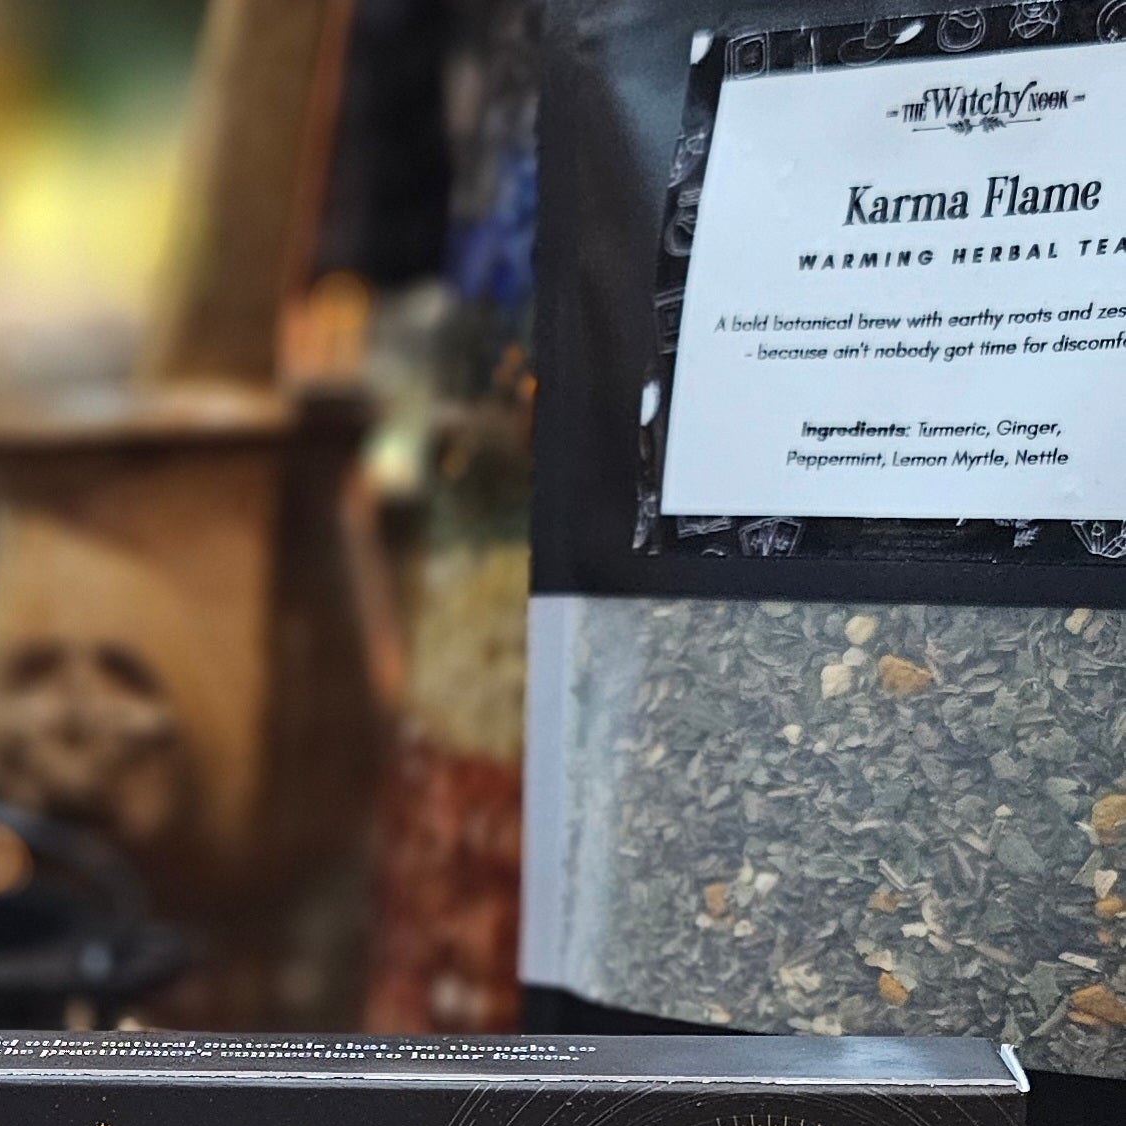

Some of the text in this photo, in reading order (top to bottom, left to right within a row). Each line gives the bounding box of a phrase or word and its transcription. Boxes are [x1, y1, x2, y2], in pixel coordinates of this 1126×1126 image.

[902, 80, 1069, 122] THE Witchy NOOK
[844, 174, 1102, 225] Karma Flame
[798, 236, 1126, 271] WARMING HERBAL TEA
[714, 315, 726, 333] A
[731, 313, 769, 332] bold
[772, 312, 853, 332] botanical
[857, 313, 902, 330] brew
[906, 311, 942, 328] with
[948, 308, 1003, 330] earthy
[1007, 307, 1052, 325] roots
[1057, 302, 1093, 322] and
[757, 343, 828, 360] because
[833, 341, 870, 359] ain't
[874, 340, 939, 363] nobody
[943, 342, 974, 362] got
[980, 341, 1016, 356] time
[1023, 336, 1047, 354] for
[1052, 330, 1126, 352] discomf
[800, 420, 1061, 441] Ingredients: Turmeric, Ginger,
[786, 448, 1069, 471] Peppermint, Lemon Myrtle, Nettle
